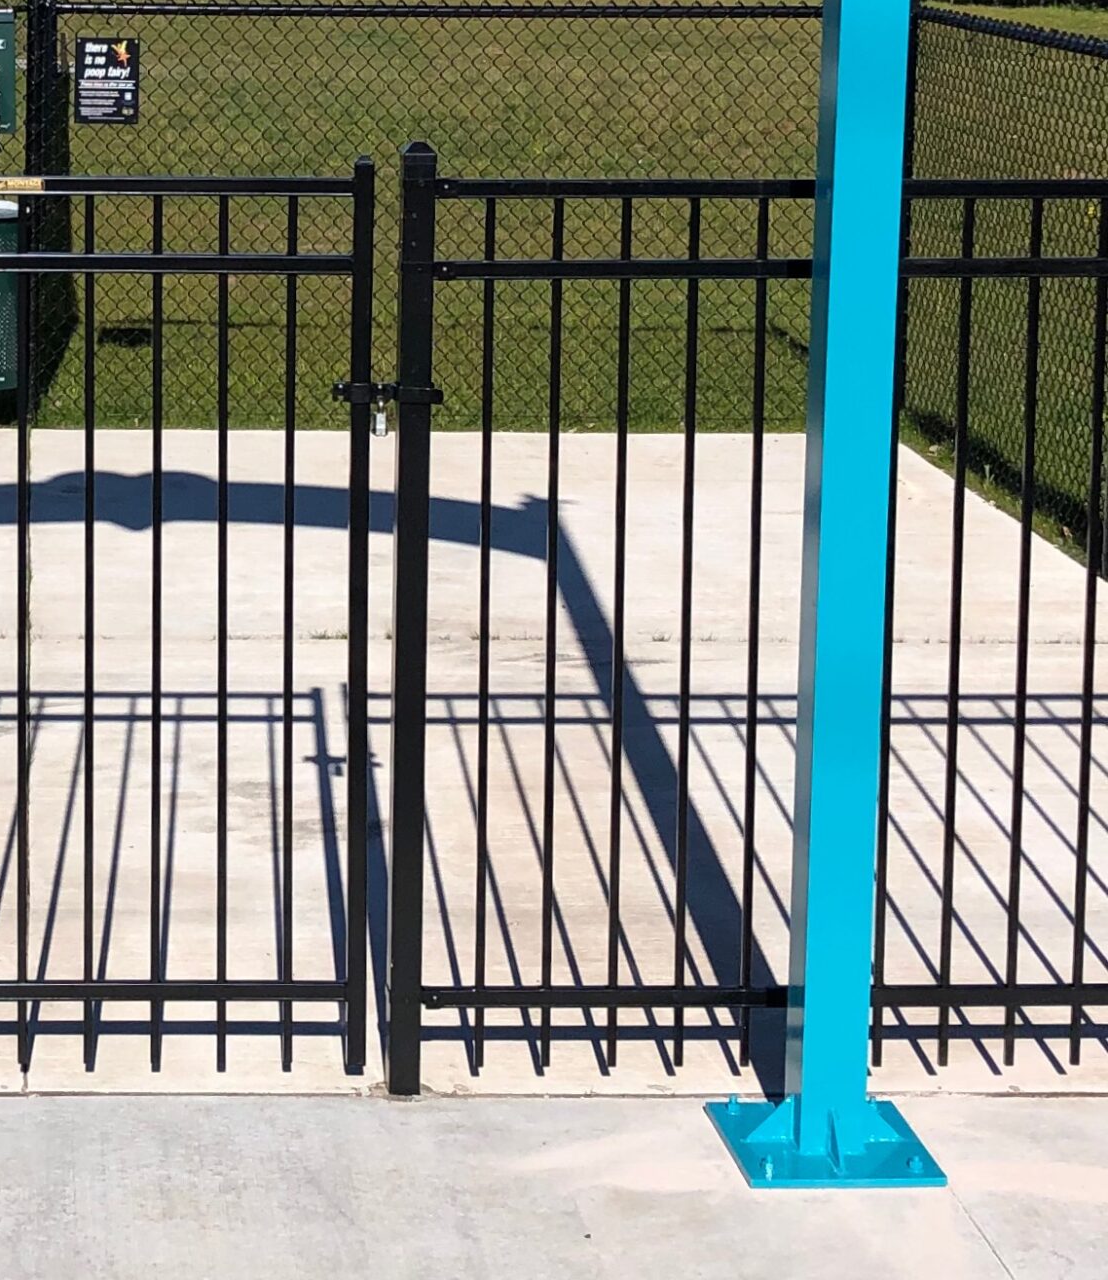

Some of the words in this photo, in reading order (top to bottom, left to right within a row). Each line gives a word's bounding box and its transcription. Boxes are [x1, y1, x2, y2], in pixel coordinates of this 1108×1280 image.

[85, 42, 108, 53] there
[84, 54, 92, 65] is
[94, 56, 106, 65] no
[84, 68, 106, 79] poop
[108, 66, 130, 79] fairy!
